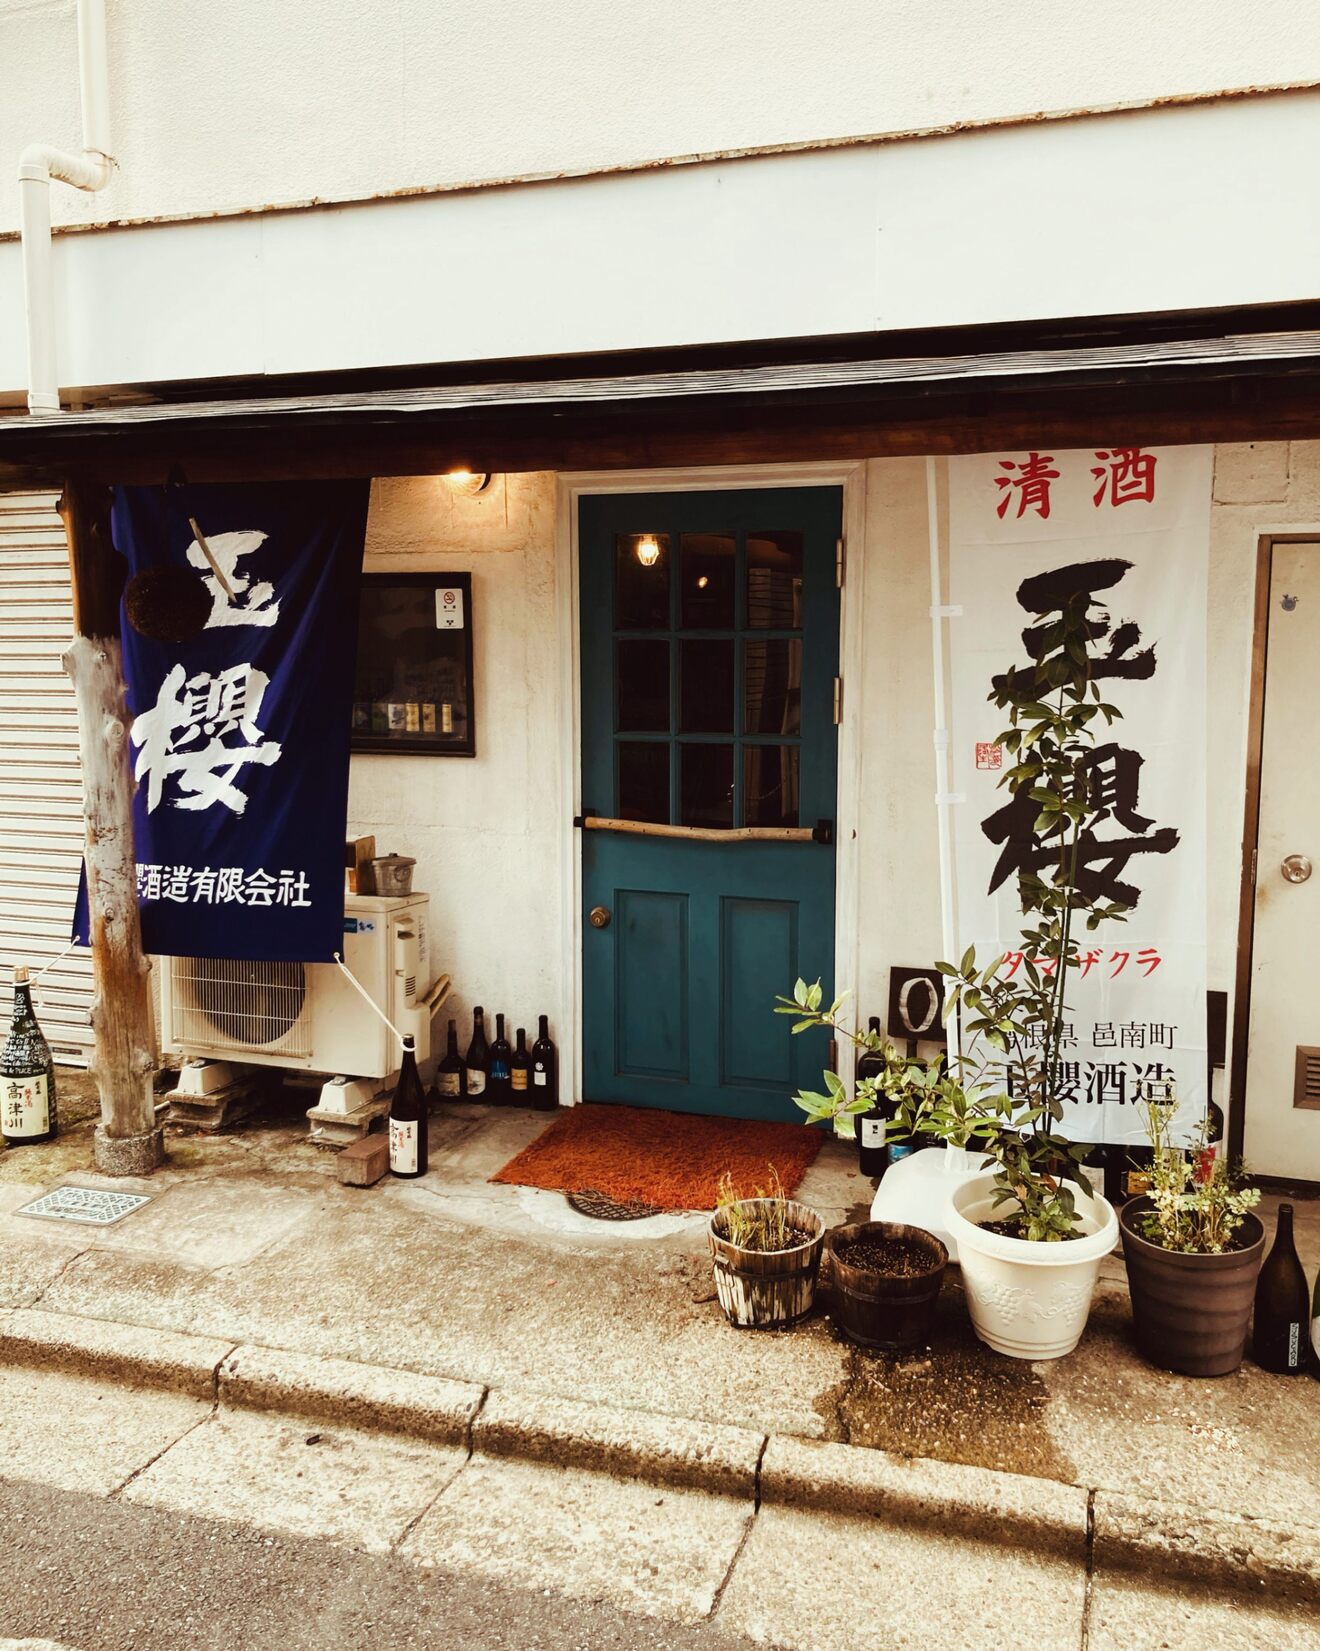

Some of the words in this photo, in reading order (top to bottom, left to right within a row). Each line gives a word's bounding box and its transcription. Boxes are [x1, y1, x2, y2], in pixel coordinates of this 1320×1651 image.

[993, 447, 1158, 520] 清酒
[1001, 947, 1163, 981] タマザクラ
[898, 976, 947, 1033] O
[1092, 1021, 1179, 1050] 邑南町
[6, 1082, 25, 1129] 高津川
